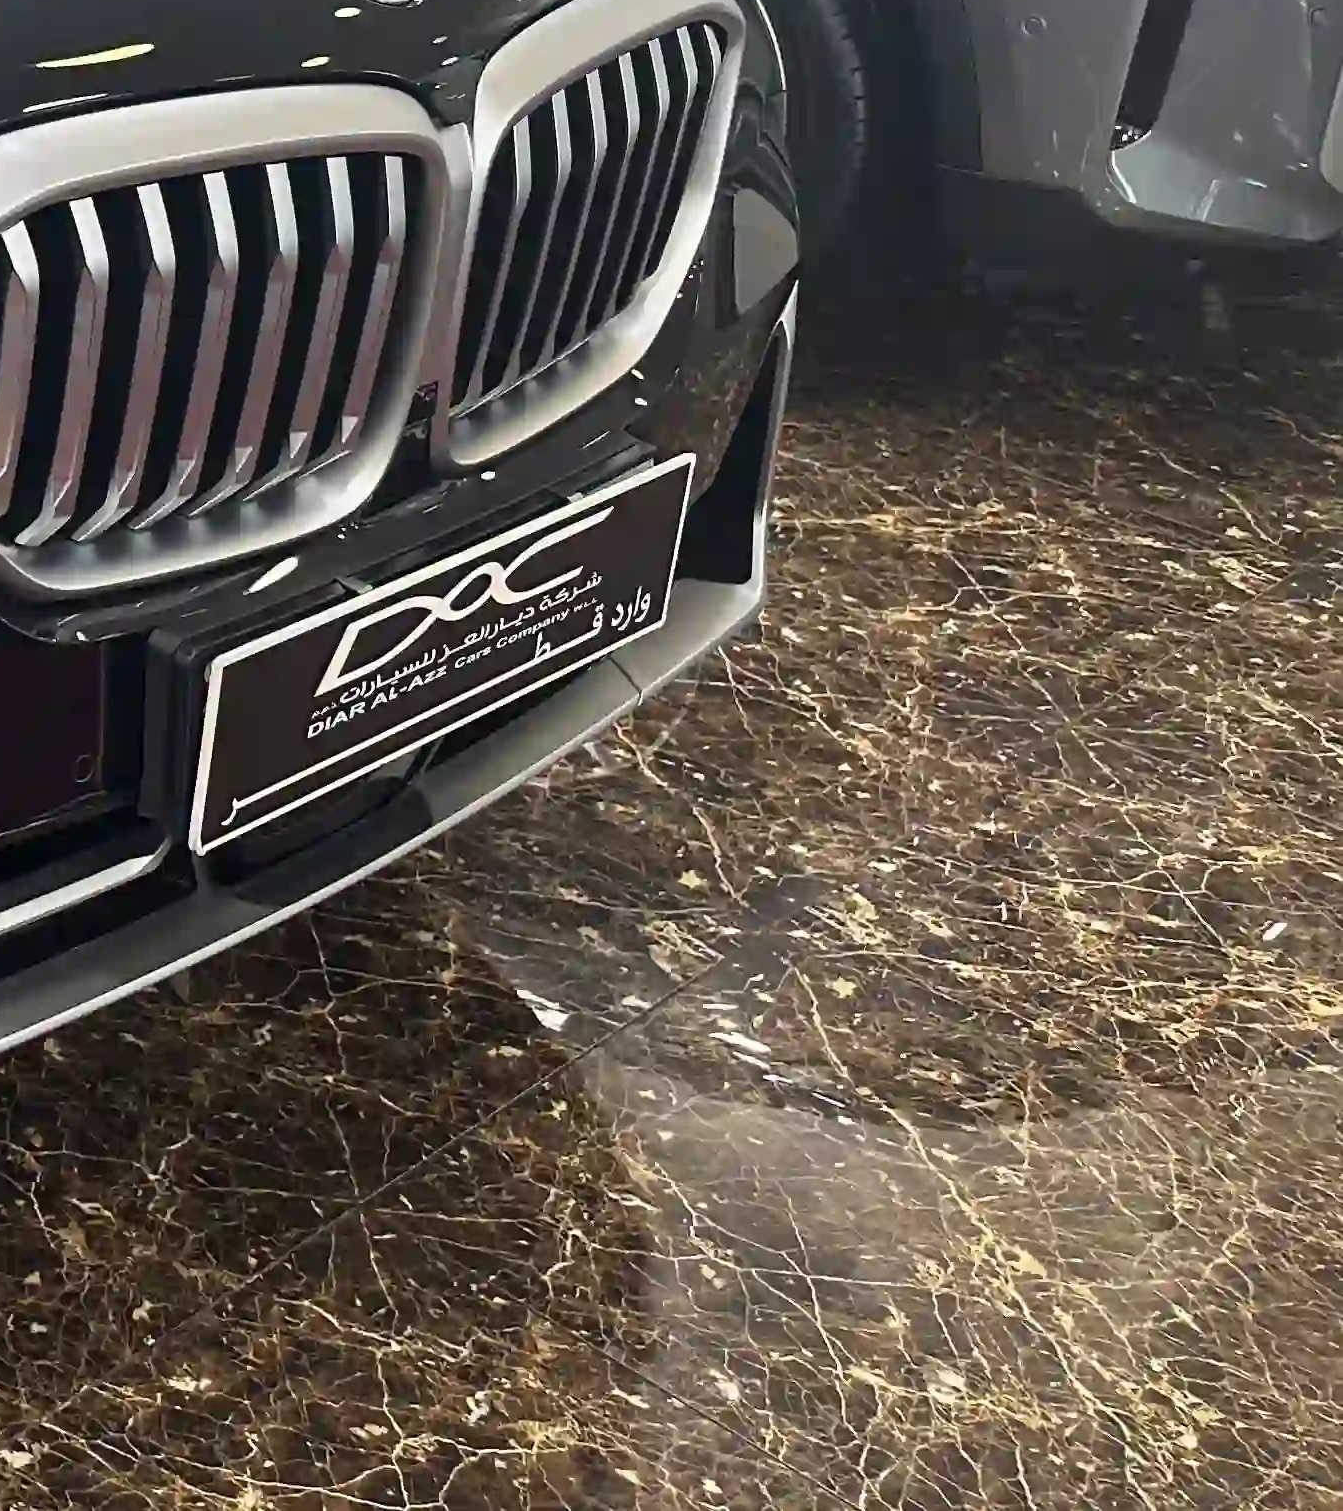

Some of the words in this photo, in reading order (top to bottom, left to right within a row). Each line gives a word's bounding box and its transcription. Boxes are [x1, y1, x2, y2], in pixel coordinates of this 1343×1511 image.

[539, 571, 603, 611] شركة
[611, 585, 650, 631] وارد
[307, 702, 366, 739] DIAR
[454, 646, 492, 669] Cars
[496, 608, 571, 649] Company
[339, 648, 437, 704] للسيارات
